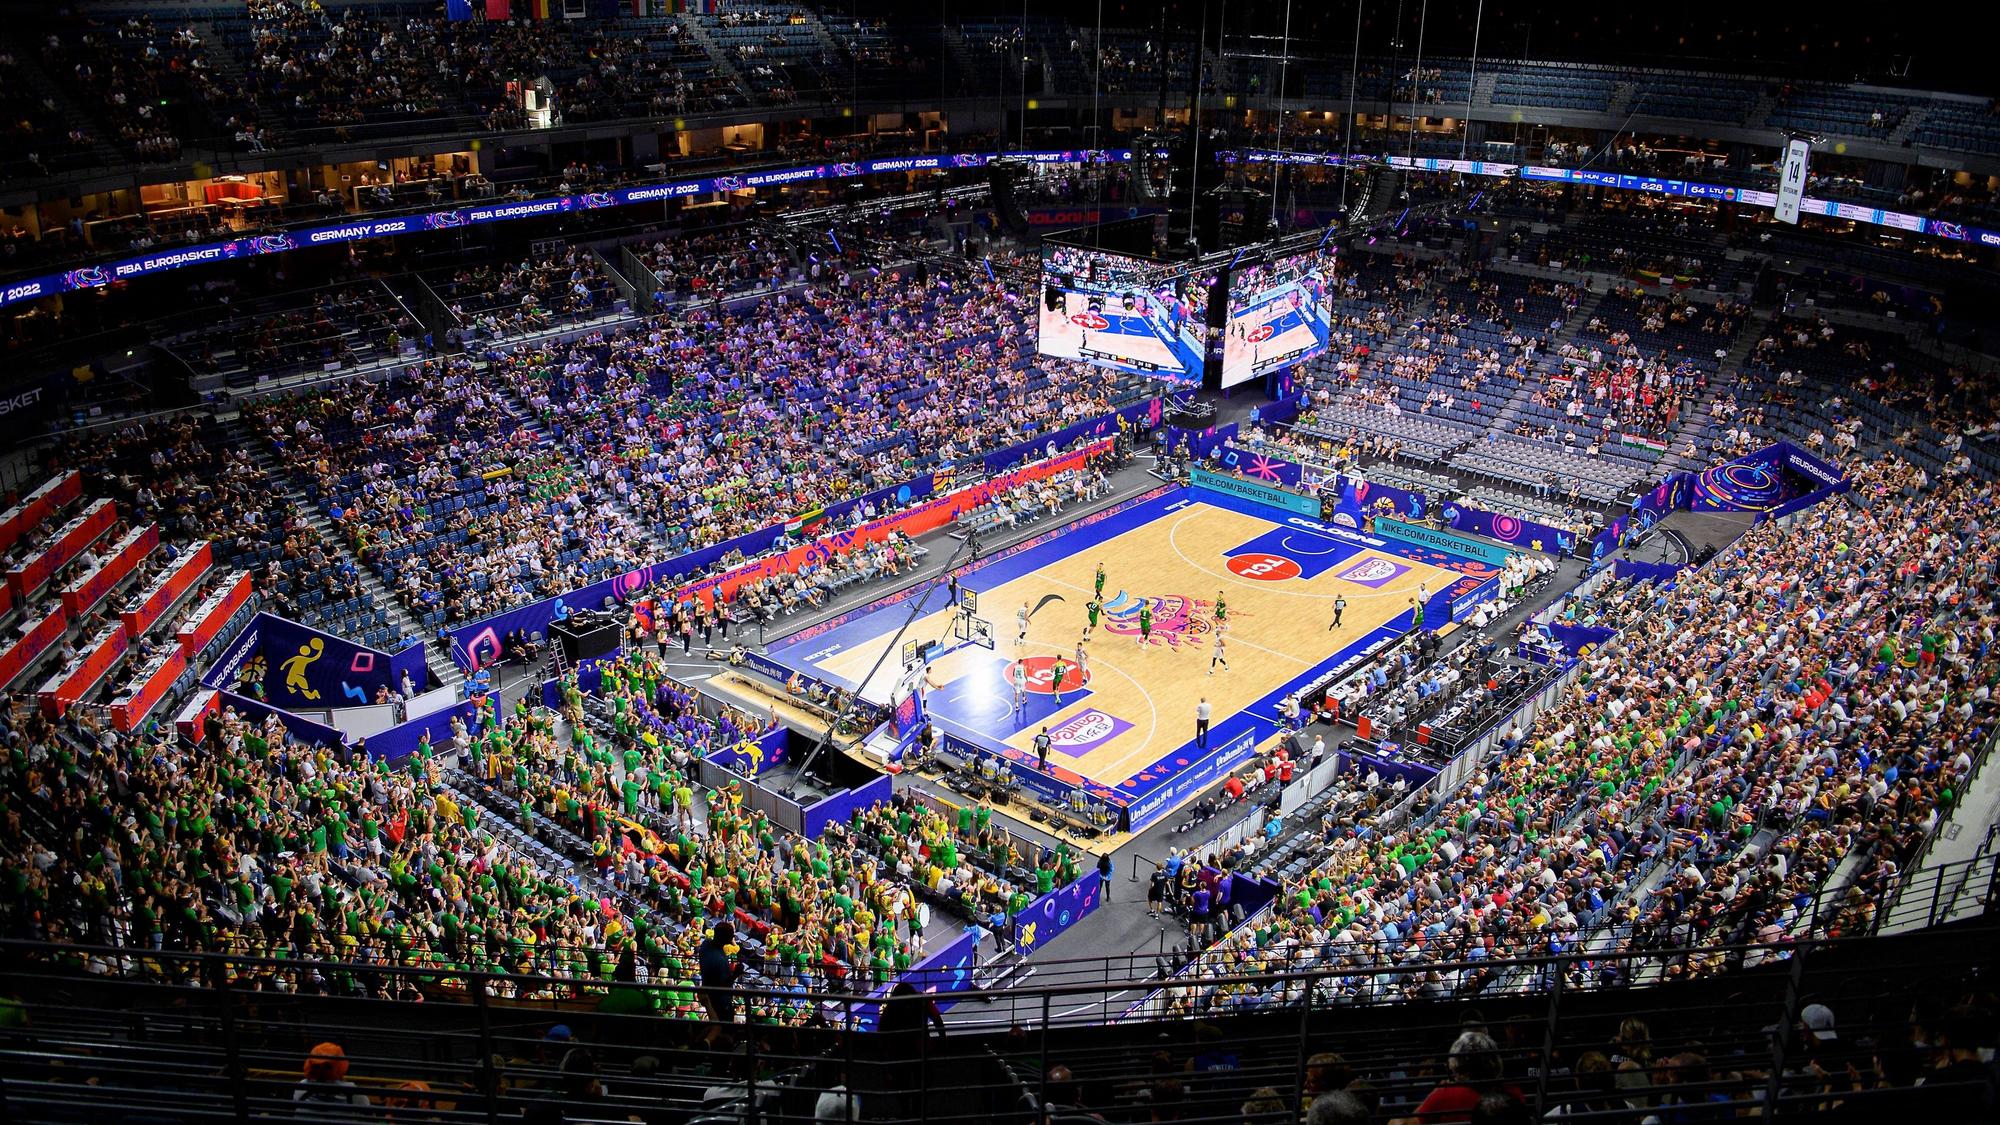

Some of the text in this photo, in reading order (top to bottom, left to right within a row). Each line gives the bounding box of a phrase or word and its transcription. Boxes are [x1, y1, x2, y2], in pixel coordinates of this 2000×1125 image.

[872, 158, 938, 171] GERMANY 2022
[1788, 161, 1801, 183] 14
[747, 169, 815, 185] FIBA EUROBASKET
[1601, 176, 1616, 184] 42
[1640, 182, 1663, 192] 5:28
[628, 183, 700, 201] GERMANY 2022
[1690, 186, 1705, 194] 64
[470, 201, 560, 221] FIBA EUROBASKET
[311, 221, 406, 242] GERMANY 2022
[116, 247, 222, 276] FIBA EUROBASKET
[8, 283, 41, 300] 2022
[0, 387, 42, 415] SKET
[1196, 474, 1288, 504] NIKE.COM/BASKETBALL
[884, 506, 931, 526] EUROBASKET
[933, 496, 951, 508] 2022
[1287, 517, 1388, 546] COLOGNE
[1381, 522, 1489, 558] NIKE.COM/BASKETBALL
[1239, 558, 1286, 576] TCL
[678, 563, 762, 598] EUROBASKET 2022
[211, 629, 258, 688] #EUROBASKET
[1131, 797, 1161, 822] Unilumin
